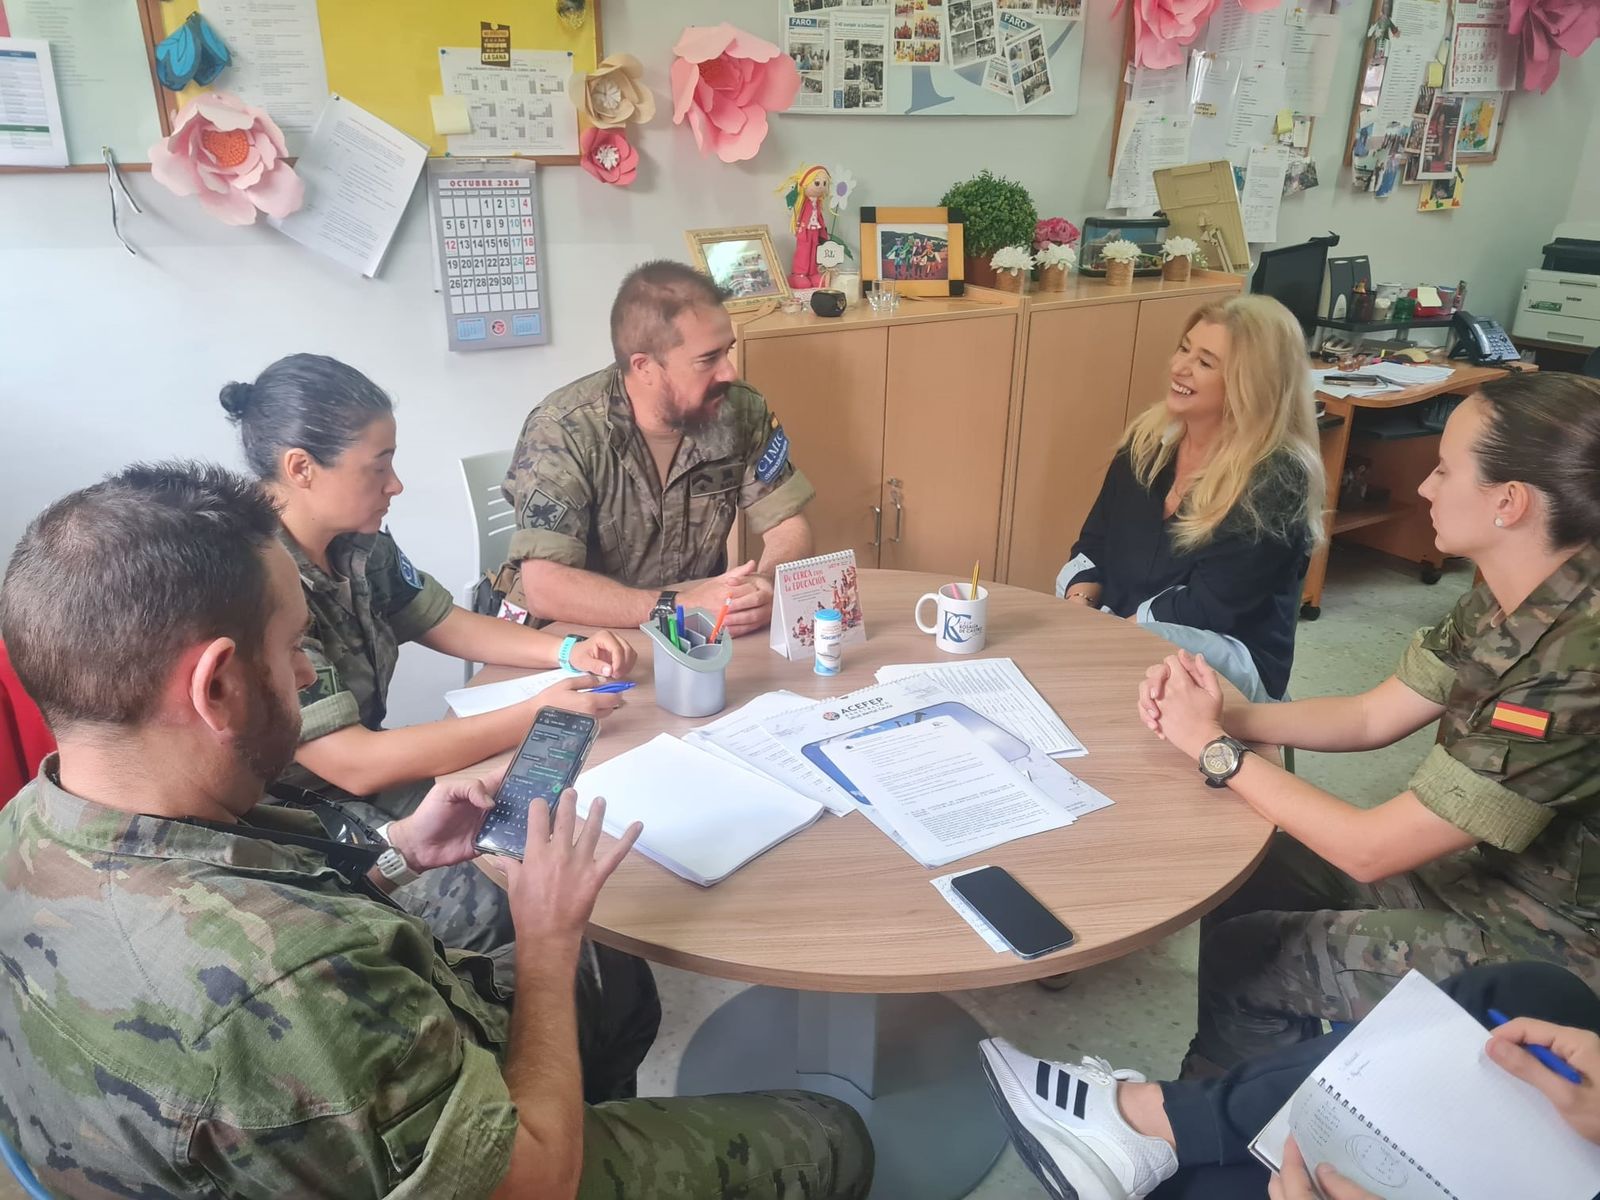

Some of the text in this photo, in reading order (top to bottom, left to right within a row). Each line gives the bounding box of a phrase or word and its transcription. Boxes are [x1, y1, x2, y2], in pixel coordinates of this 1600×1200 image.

[1004, 13, 1028, 29] FARO
[484, 199, 528, 208] 1 2 3 4
[446, 218, 532, 230] 5 6 7 8 9 10 11
[446, 238, 534, 250] 12 13 14 15 16 17 18
[448, 257, 535, 269] 19 20 21 22 23 24 25
[450, 276, 523, 288] 26 27 28 29 30 31
[758, 428, 784, 472] CIMIC
[793, 569, 812, 581] CERCA
[792, 576, 827, 590] EDUCACIÓN
[841, 697, 883, 714] ACEFEP
